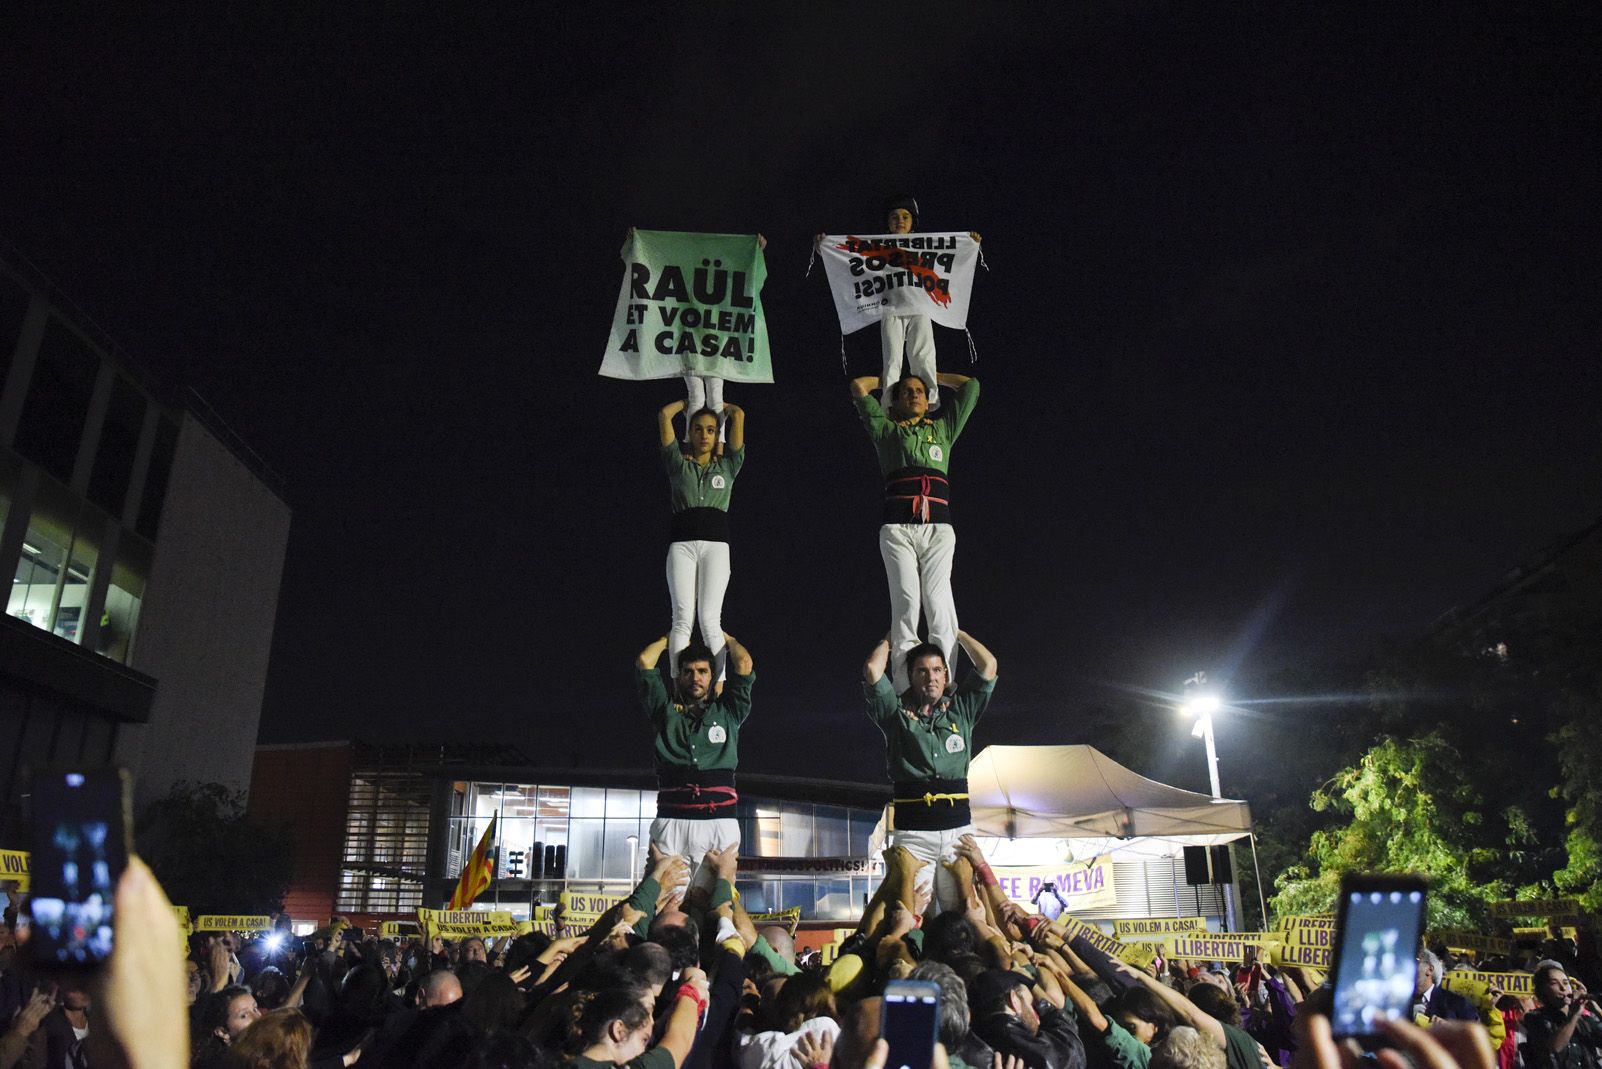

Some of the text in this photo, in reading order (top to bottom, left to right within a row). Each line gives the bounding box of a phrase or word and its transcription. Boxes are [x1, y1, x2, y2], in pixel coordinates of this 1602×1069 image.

[626, 303, 756, 335] ET VOLEM
[619, 328, 755, 363] A CASA!
[1028, 865, 1105, 897] RMEVA
[571, 896, 586, 912] US
[203, 918, 267, 928] US VOLEM A CASA!
[437, 911, 490, 925] LLIBERTAT!
[437, 922, 519, 935] US VOLEM A CASA!
[1119, 920, 1199, 934] US VOLEM A CASA!
[1065, 918, 1127, 956] LLIBERTAT!
[1142, 942, 1153, 953] US
